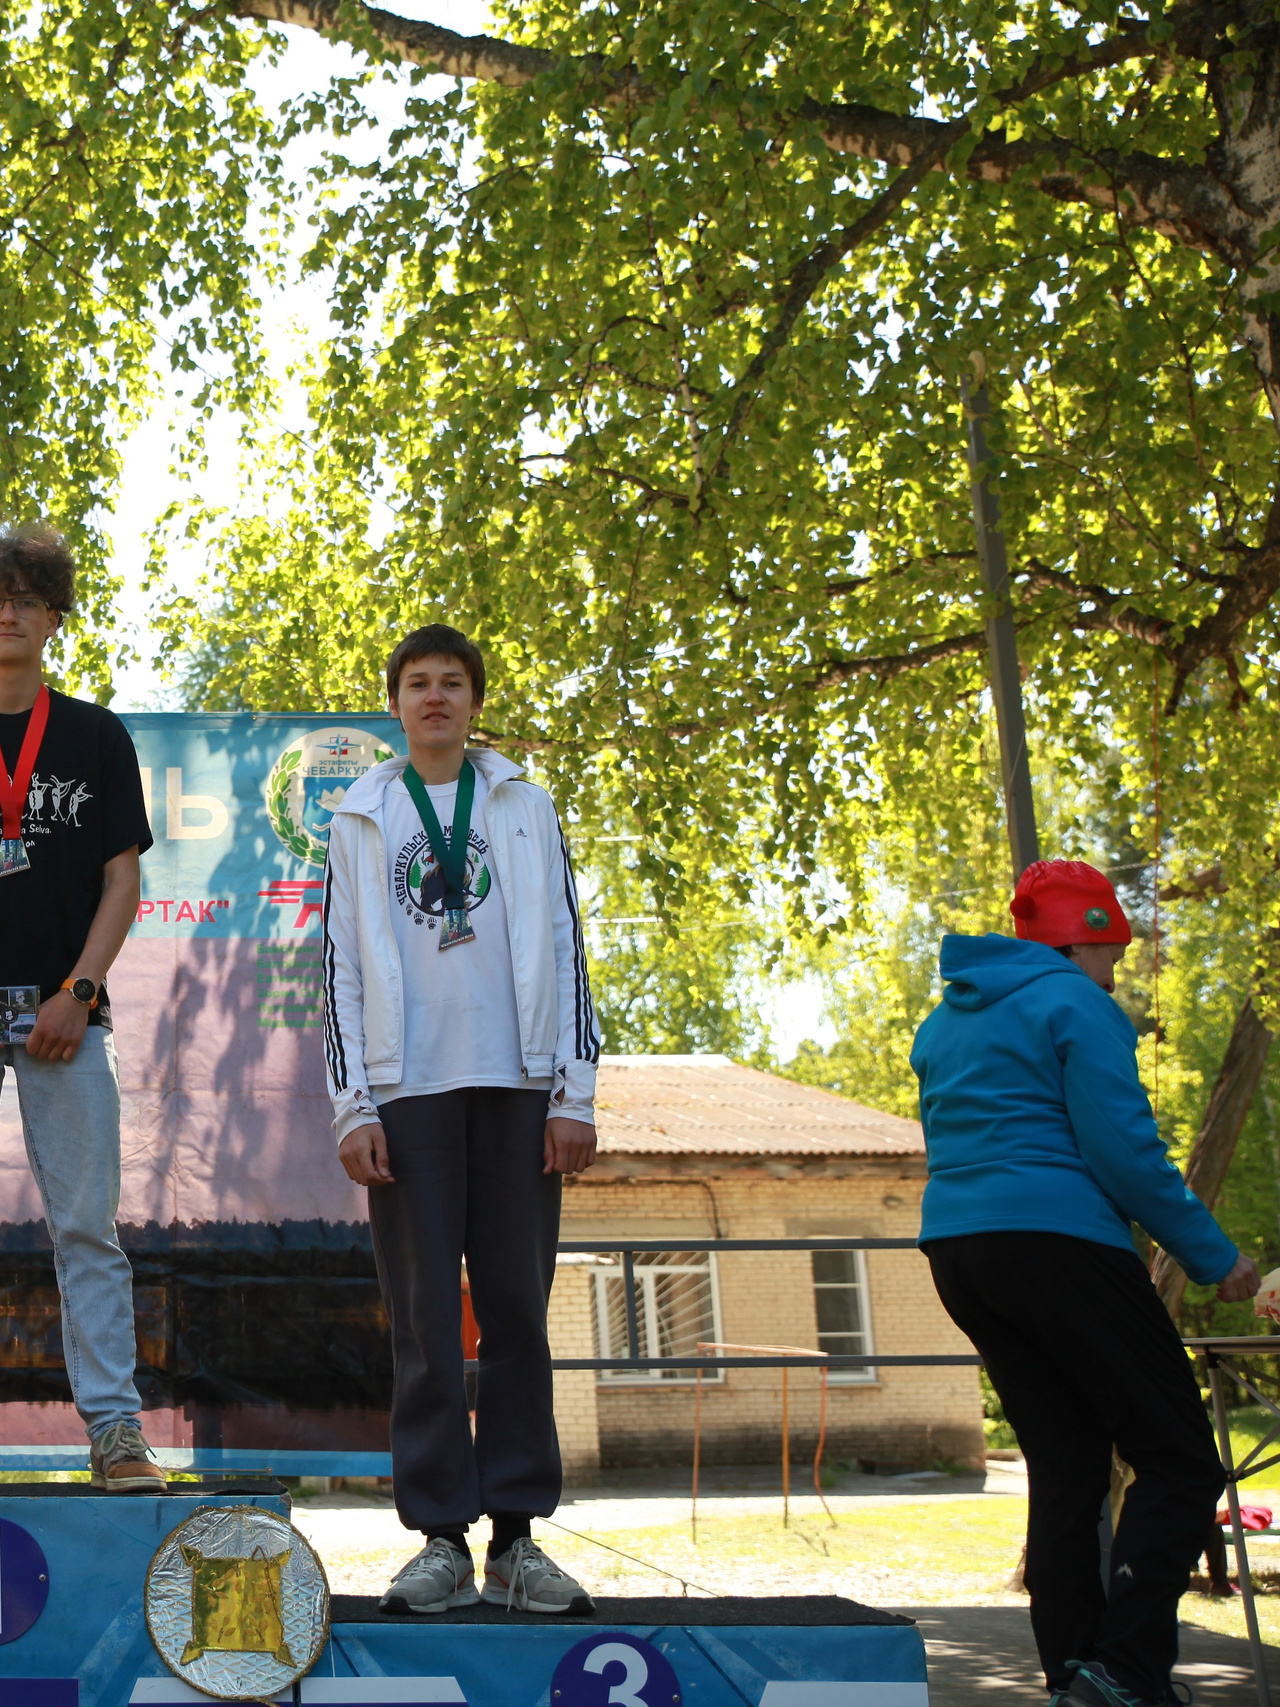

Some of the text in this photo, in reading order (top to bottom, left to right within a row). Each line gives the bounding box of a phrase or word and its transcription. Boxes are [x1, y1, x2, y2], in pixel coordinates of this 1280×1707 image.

[302, 766, 372, 776] ЧЕБАРКУЛ
[318, 760, 358, 768] эстафеты
[394, 830, 429, 906] ЧЕБАРКУЛЬСК
[134, 900, 229, 923] РТАК"
[582, 1642, 650, 1707] 3
